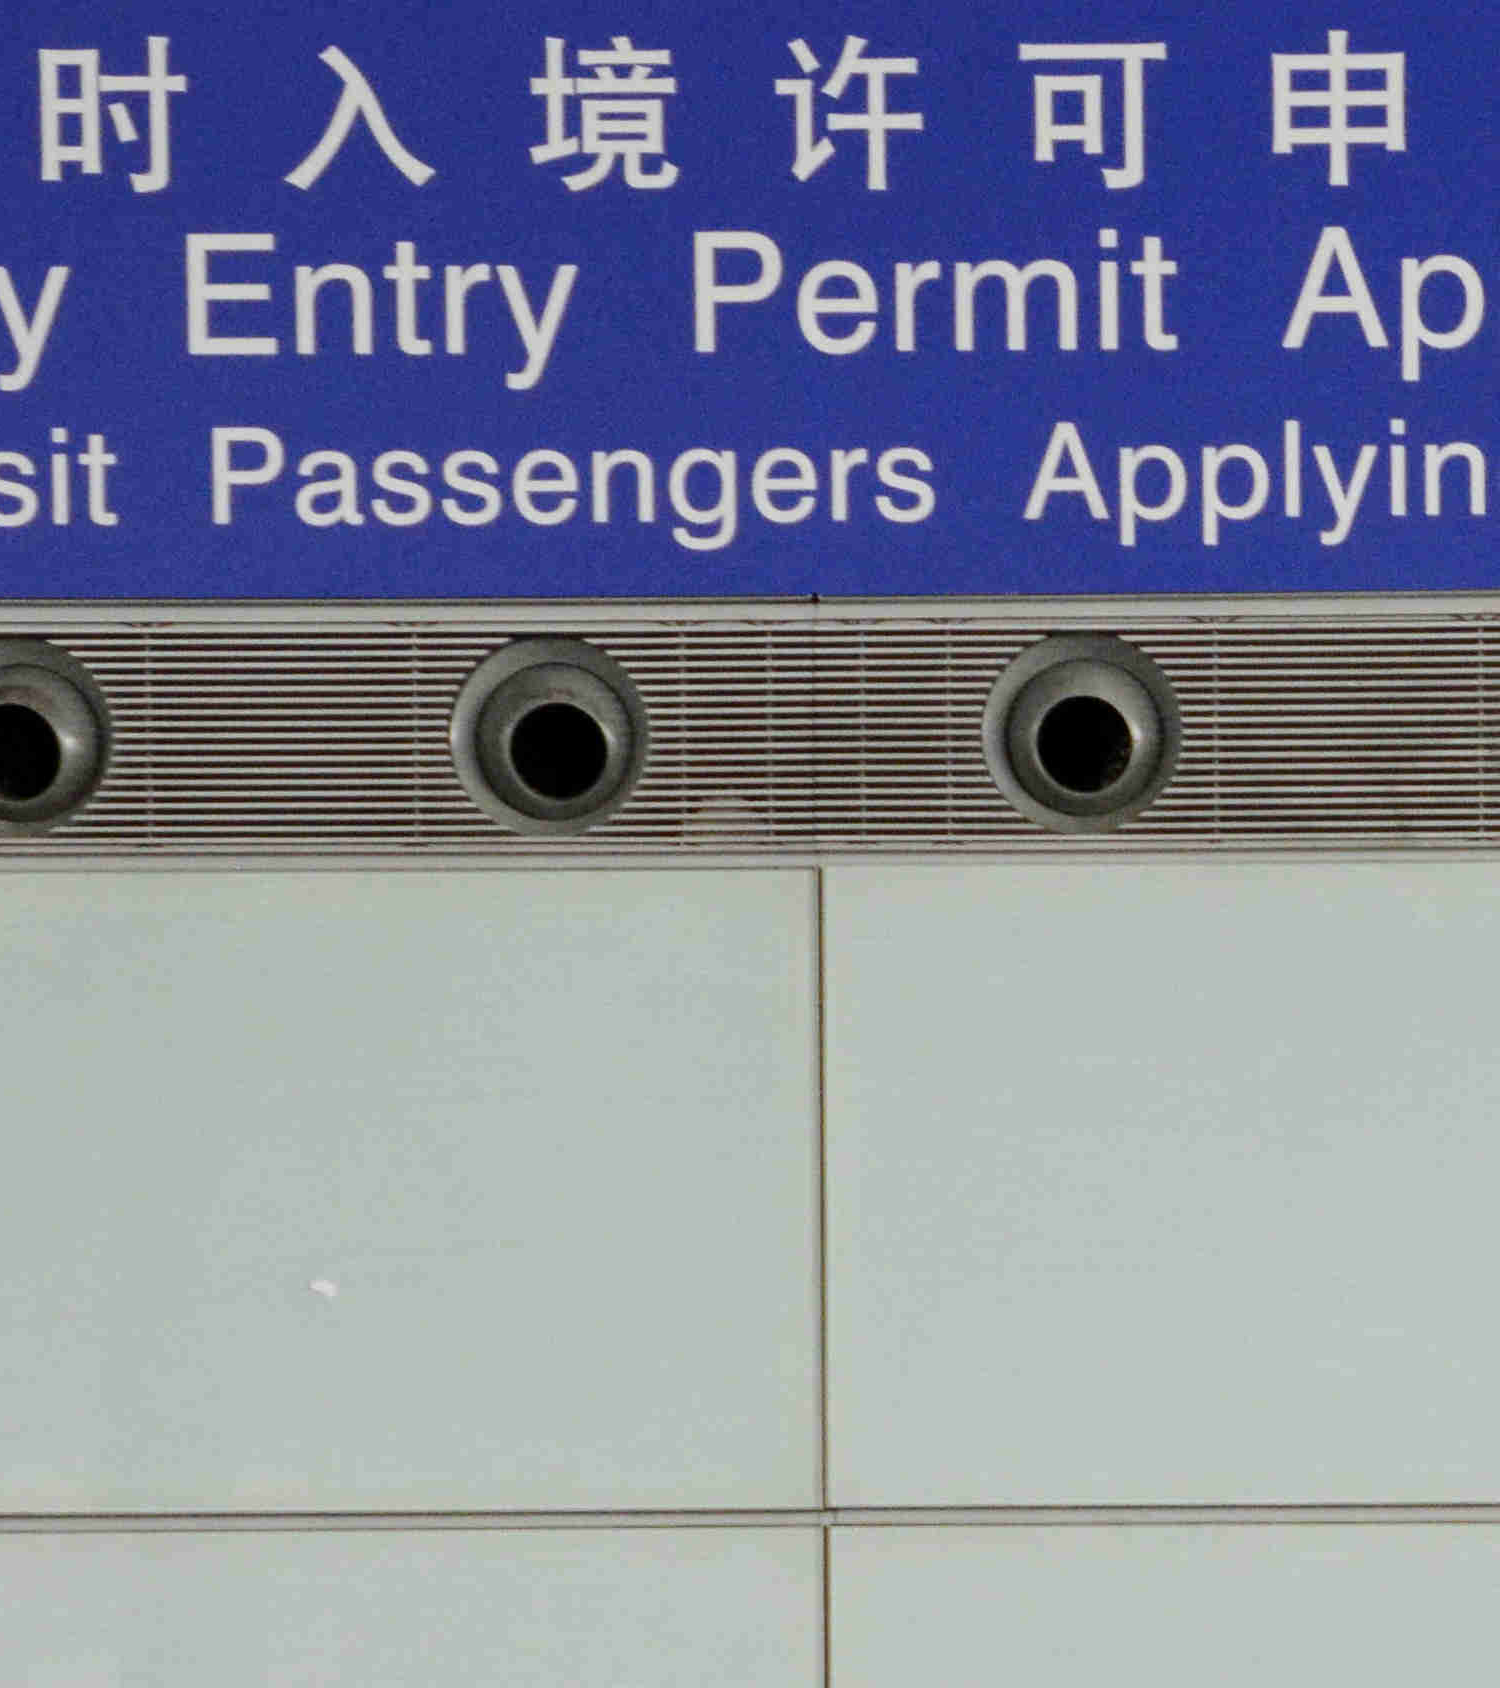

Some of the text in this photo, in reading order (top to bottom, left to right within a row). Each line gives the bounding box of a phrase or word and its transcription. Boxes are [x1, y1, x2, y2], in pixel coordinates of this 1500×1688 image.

[186, 233, 578, 390] Entry
[694, 228, 1178, 355] Permit
[212, 427, 935, 551] Passengers
